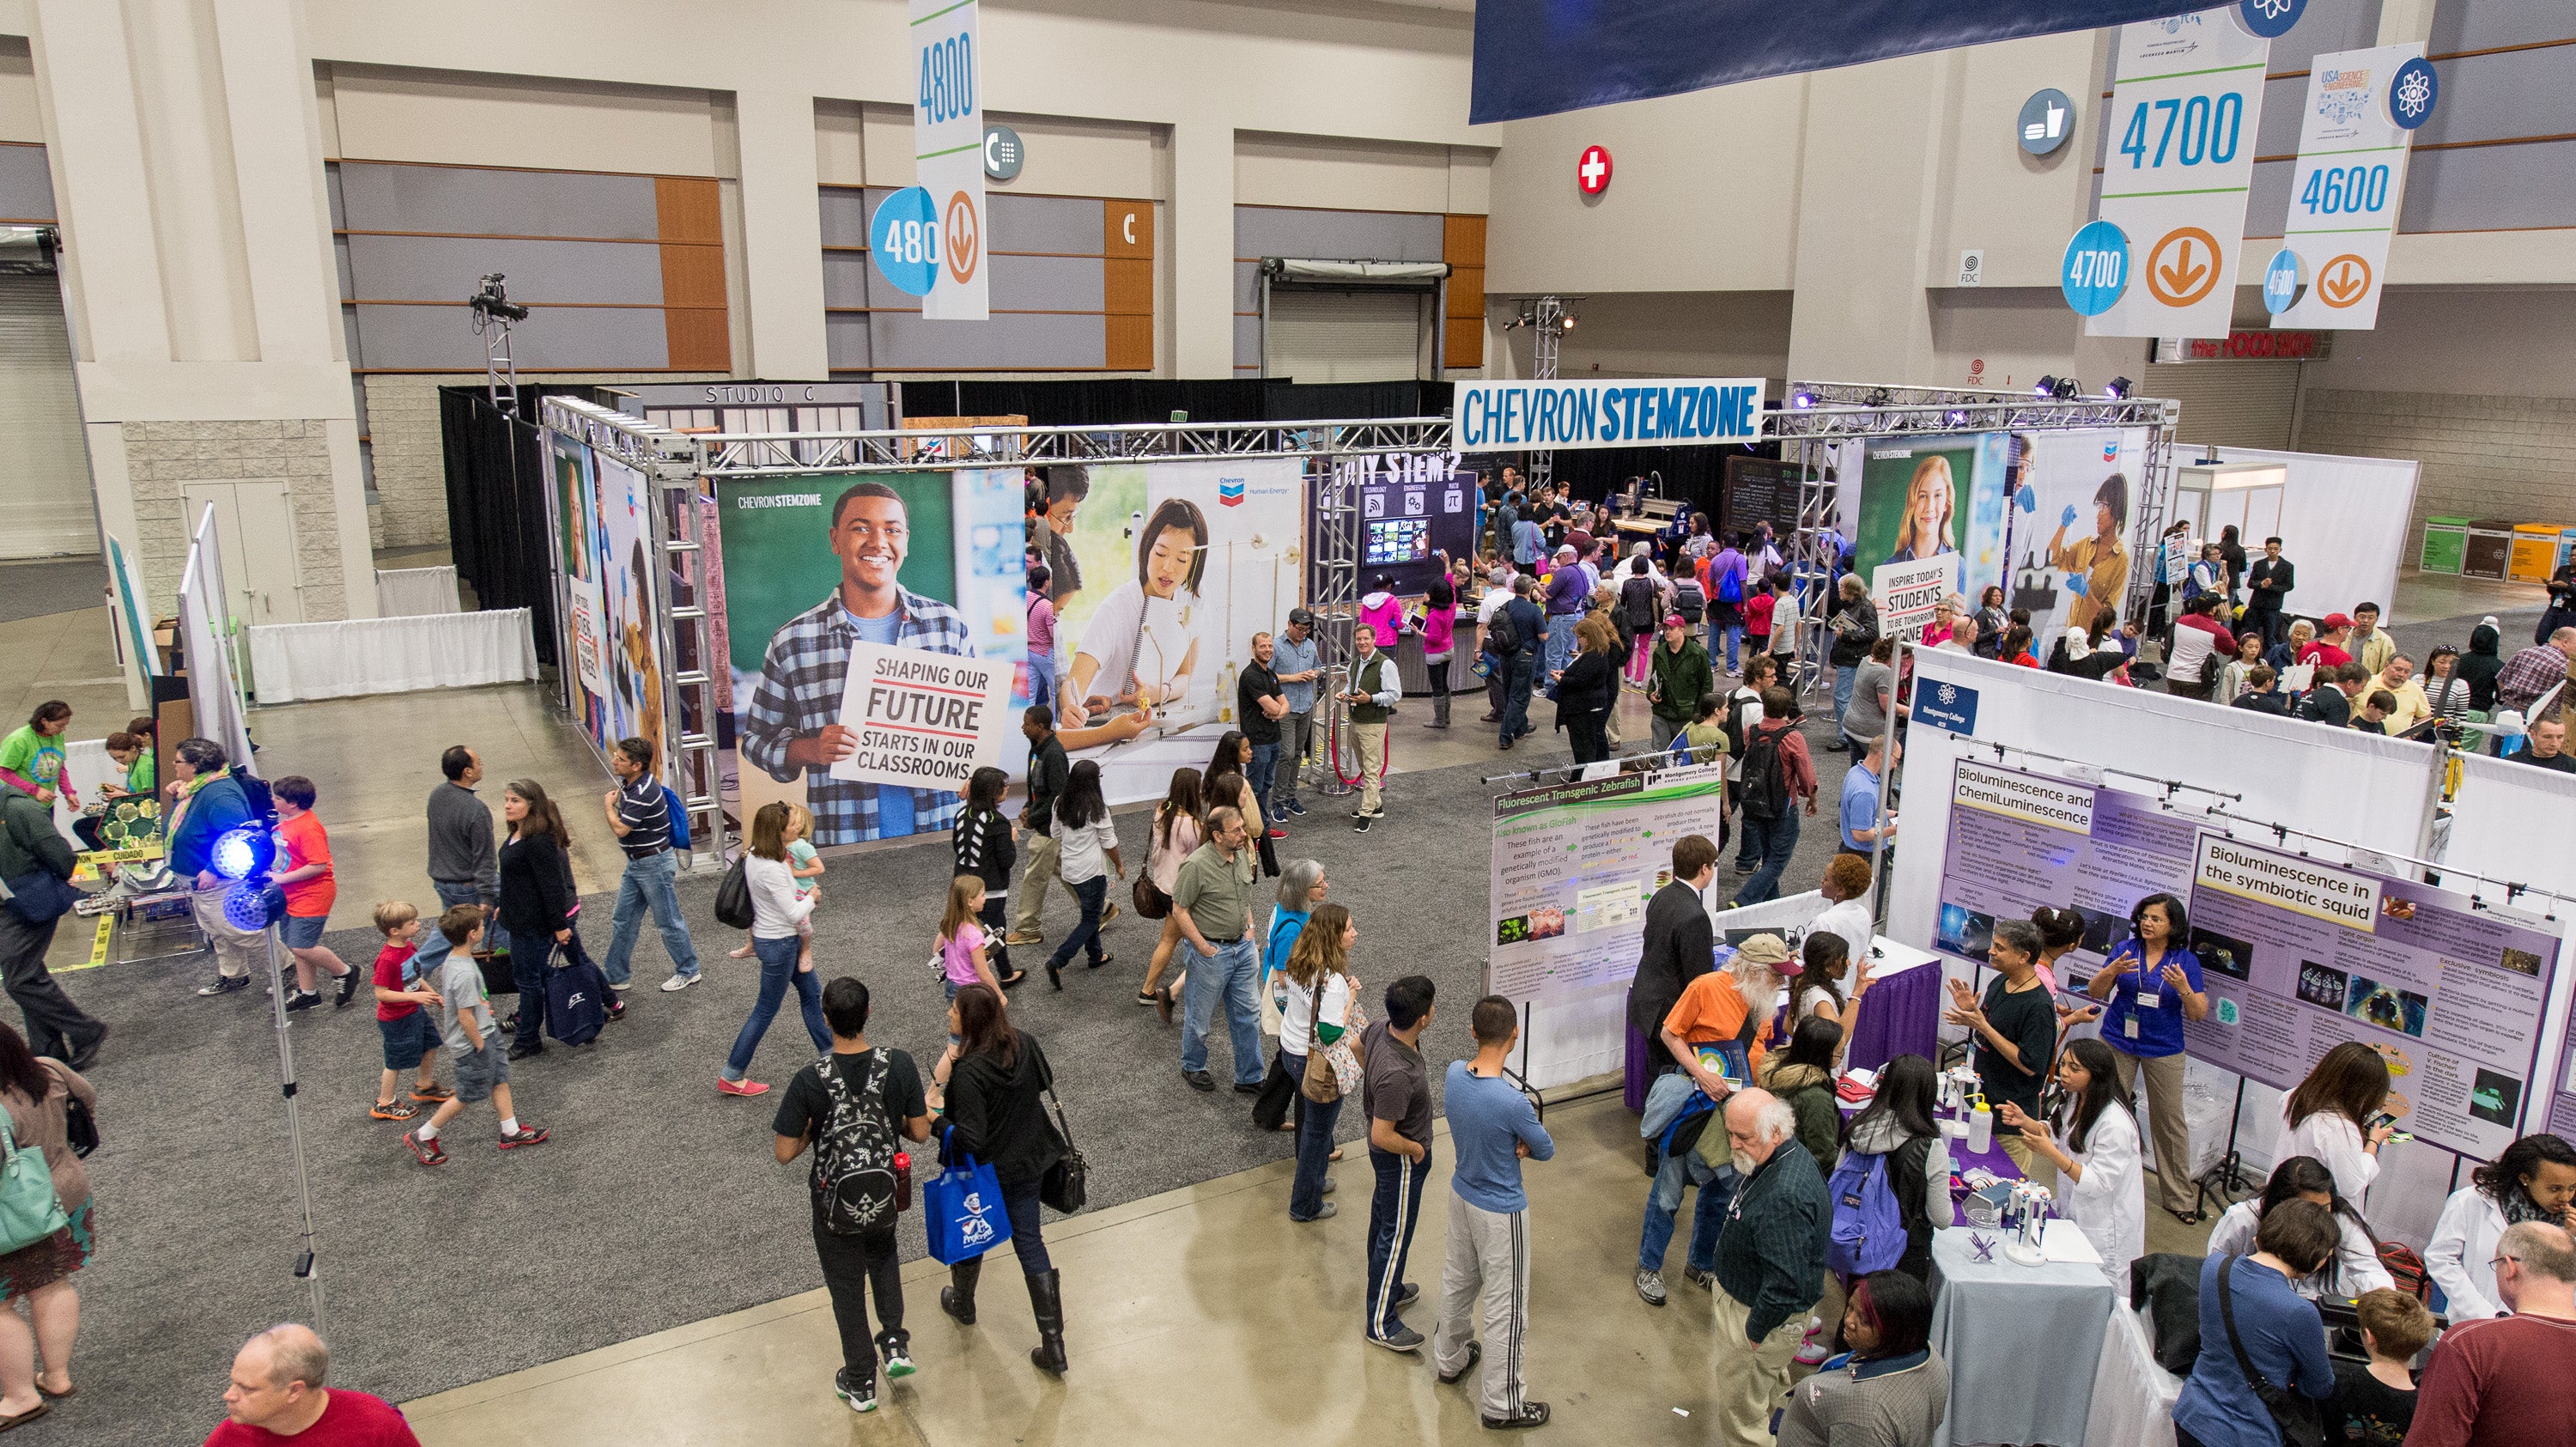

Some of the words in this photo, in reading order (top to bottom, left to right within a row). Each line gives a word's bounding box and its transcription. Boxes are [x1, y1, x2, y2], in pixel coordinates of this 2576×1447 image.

[920, 32, 973, 125] 4800
[2322, 70, 2338, 83] USA
[2339, 70, 2364, 81] SCIENCE
[2120, 92, 2243, 170] 4700
[2300, 164, 2390, 216] 4600
[884, 220, 939, 264] 480
[1960, 273, 1978, 283] FDC
[2069, 250, 2121, 288] 4700
[2268, 269, 2295, 296] 4600
[2191, 339, 2218, 358] the
[2222, 332, 2274, 357] FOOD
[2275, 331, 2314, 358] SHOW
[1966, 375, 1984, 386] FDC
[706, 386, 785, 403] STUDIO
[805, 386, 816, 401] C
[1385, 451, 1462, 484] STEM?
[1888, 574, 1915, 588] INSPIRE
[1917, 568, 1943, 584] TODAY'S
[1887, 586, 1941, 612] STUDENTS
[1887, 620, 1894, 629] TO
[1895, 618, 1902, 627] BE
[875, 658, 950, 684] SHAPING
[955, 669, 988, 690] OUR
[866, 687, 983, 732] FUTURE
[1923, 705, 1949, 720] Montgomery
[1949, 712, 1965, 724] College
[861, 730, 919, 752] STARTS
[922, 738, 939, 755] IN
[944, 740, 975, 759] OUR
[857, 751, 972, 781] CLASSROOMS.
[1665, 769, 1697, 779] Montgomery
[1698, 766, 1717, 775] College
[1498, 792, 1549, 811] Fluorescent
[1552, 785, 1598, 799] Transgenic
[1601, 777, 1640, 793] Zebrafish
[1959, 767, 2063, 802] Bioluminescence
[2067, 792, 2092, 809] and
[1654, 812, 1675, 821] Zebrafish
[1693, 806, 1714, 815] normally
[1959, 784, 2087, 825] ChemiLuminescence
[1495, 829, 1510, 837] Also
[1512, 823, 1536, 835] known
[1549, 816, 1576, 828] GloFish
[1667, 818, 1686, 827] produce
[1507, 839, 1526, 848] These
[1528, 836, 1540, 845] fish
[1582, 830, 1609, 842] genetically
[1610, 826, 1633, 836] modified
[113, 849, 143, 860] CUIDADO
[1513, 848, 1542, 860] example
[1582, 850, 1600, 859] protein
[1583, 841, 1604, 850] produce
[2118, 847, 2140, 857] purpose
[1501, 860, 1535, 875] genetically
[1538, 854, 1567, 866] modified
[2101, 854, 2127, 866] Attracting
[2147, 866, 2178, 879] Camouflage
[2137, 857, 2158, 867] Warning
[1505, 870, 1535, 885] organism
[1538, 866, 1562, 881] (GMO).
[2210, 845, 2348, 894] Bioluminescence
[2354, 881, 2369, 899] in
[2075, 885, 2089, 894] Firefly
[2205, 864, 2233, 883] the
[2236, 872, 2317, 907] symbiotic
[2322, 897, 2370, 921] squid
[2074, 891, 2093, 902] warning
[2101, 899, 2125, 909] predators
[2339, 928, 2354, 938] Light
[2356, 934, 2375, 944] organ
[2439, 956, 2470, 970] Exclusive
[2475, 966, 2508, 982] symbiosis
[2247, 991, 2262, 1000] When
[2270, 999, 2284, 1008] make
[2286, 1004, 2298, 1012] light
[2324, 1018, 2341, 1026] genes
[2427, 1051, 2450, 1062] Culture
[2445, 1069, 2458, 1079] dark
